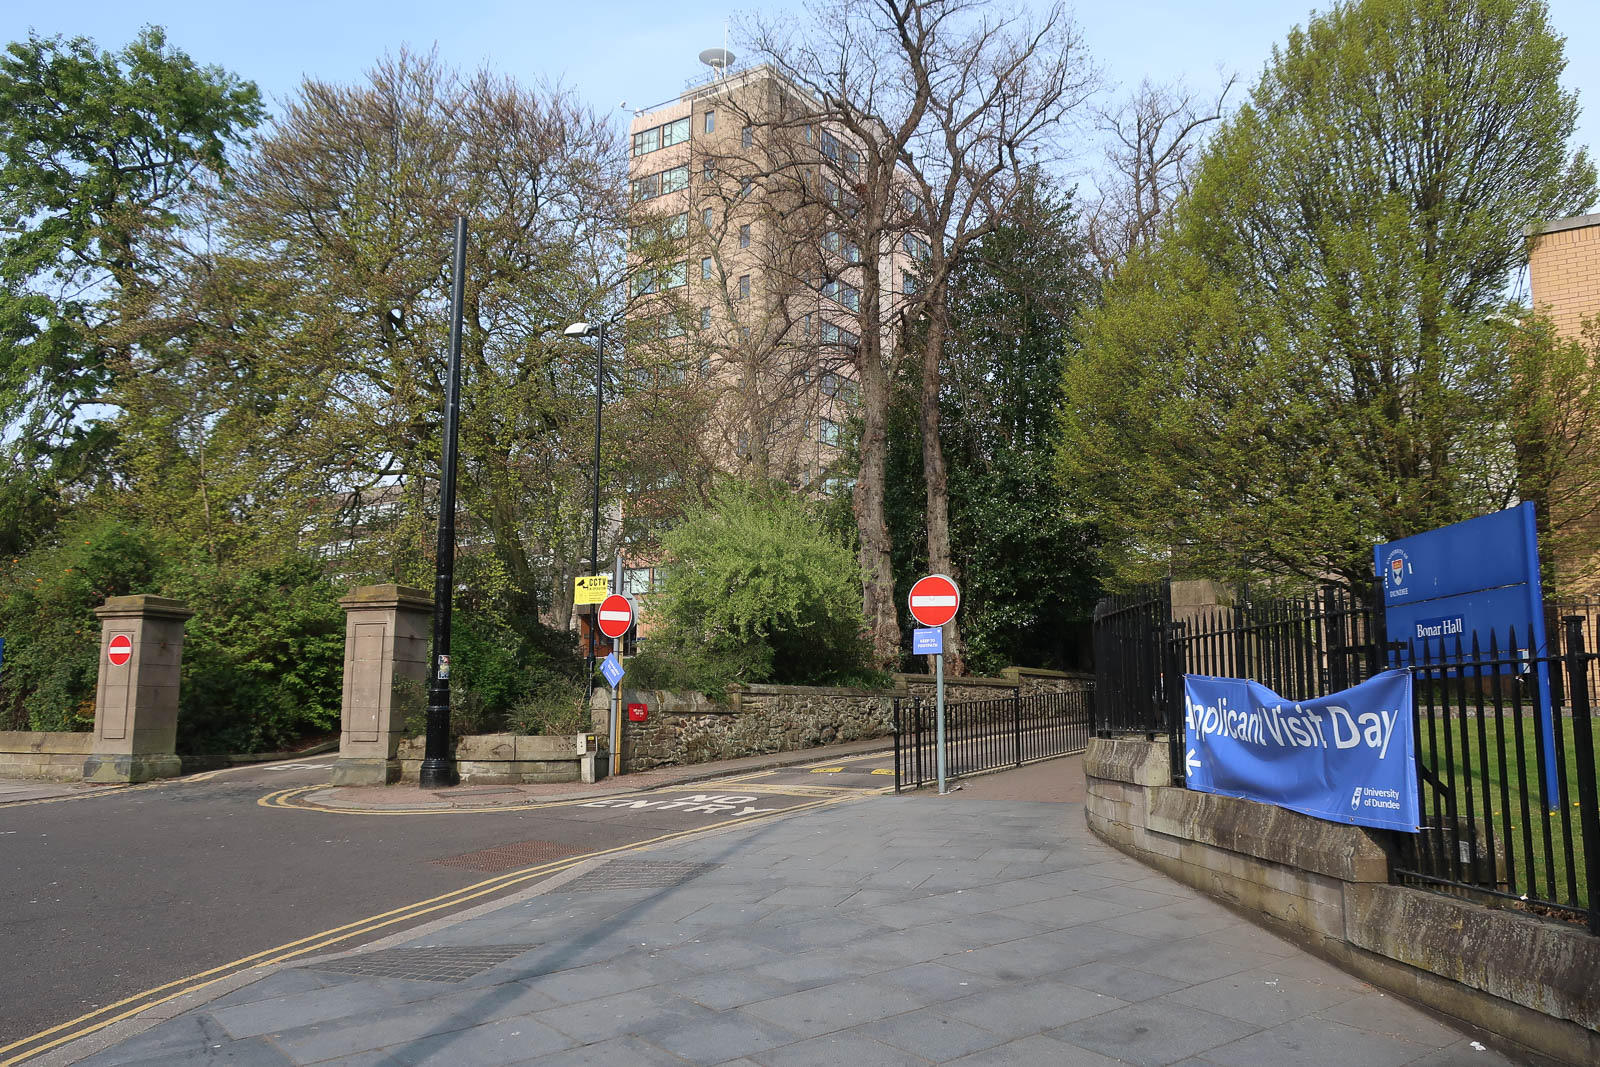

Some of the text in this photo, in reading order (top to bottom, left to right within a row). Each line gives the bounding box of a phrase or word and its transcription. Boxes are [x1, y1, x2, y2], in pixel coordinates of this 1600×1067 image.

[589, 578, 607, 587] CCTV
[1416, 618, 1463, 638] Bonar Hall
[1262, 704, 1328, 749] Visit
[1326, 705, 1399, 760] Day
[673, 794, 758, 804] NO
[1363, 787, 1400, 799] University
[577, 799, 778, 816] ENTRY
[1364, 799, 1400, 810] of Dundee
